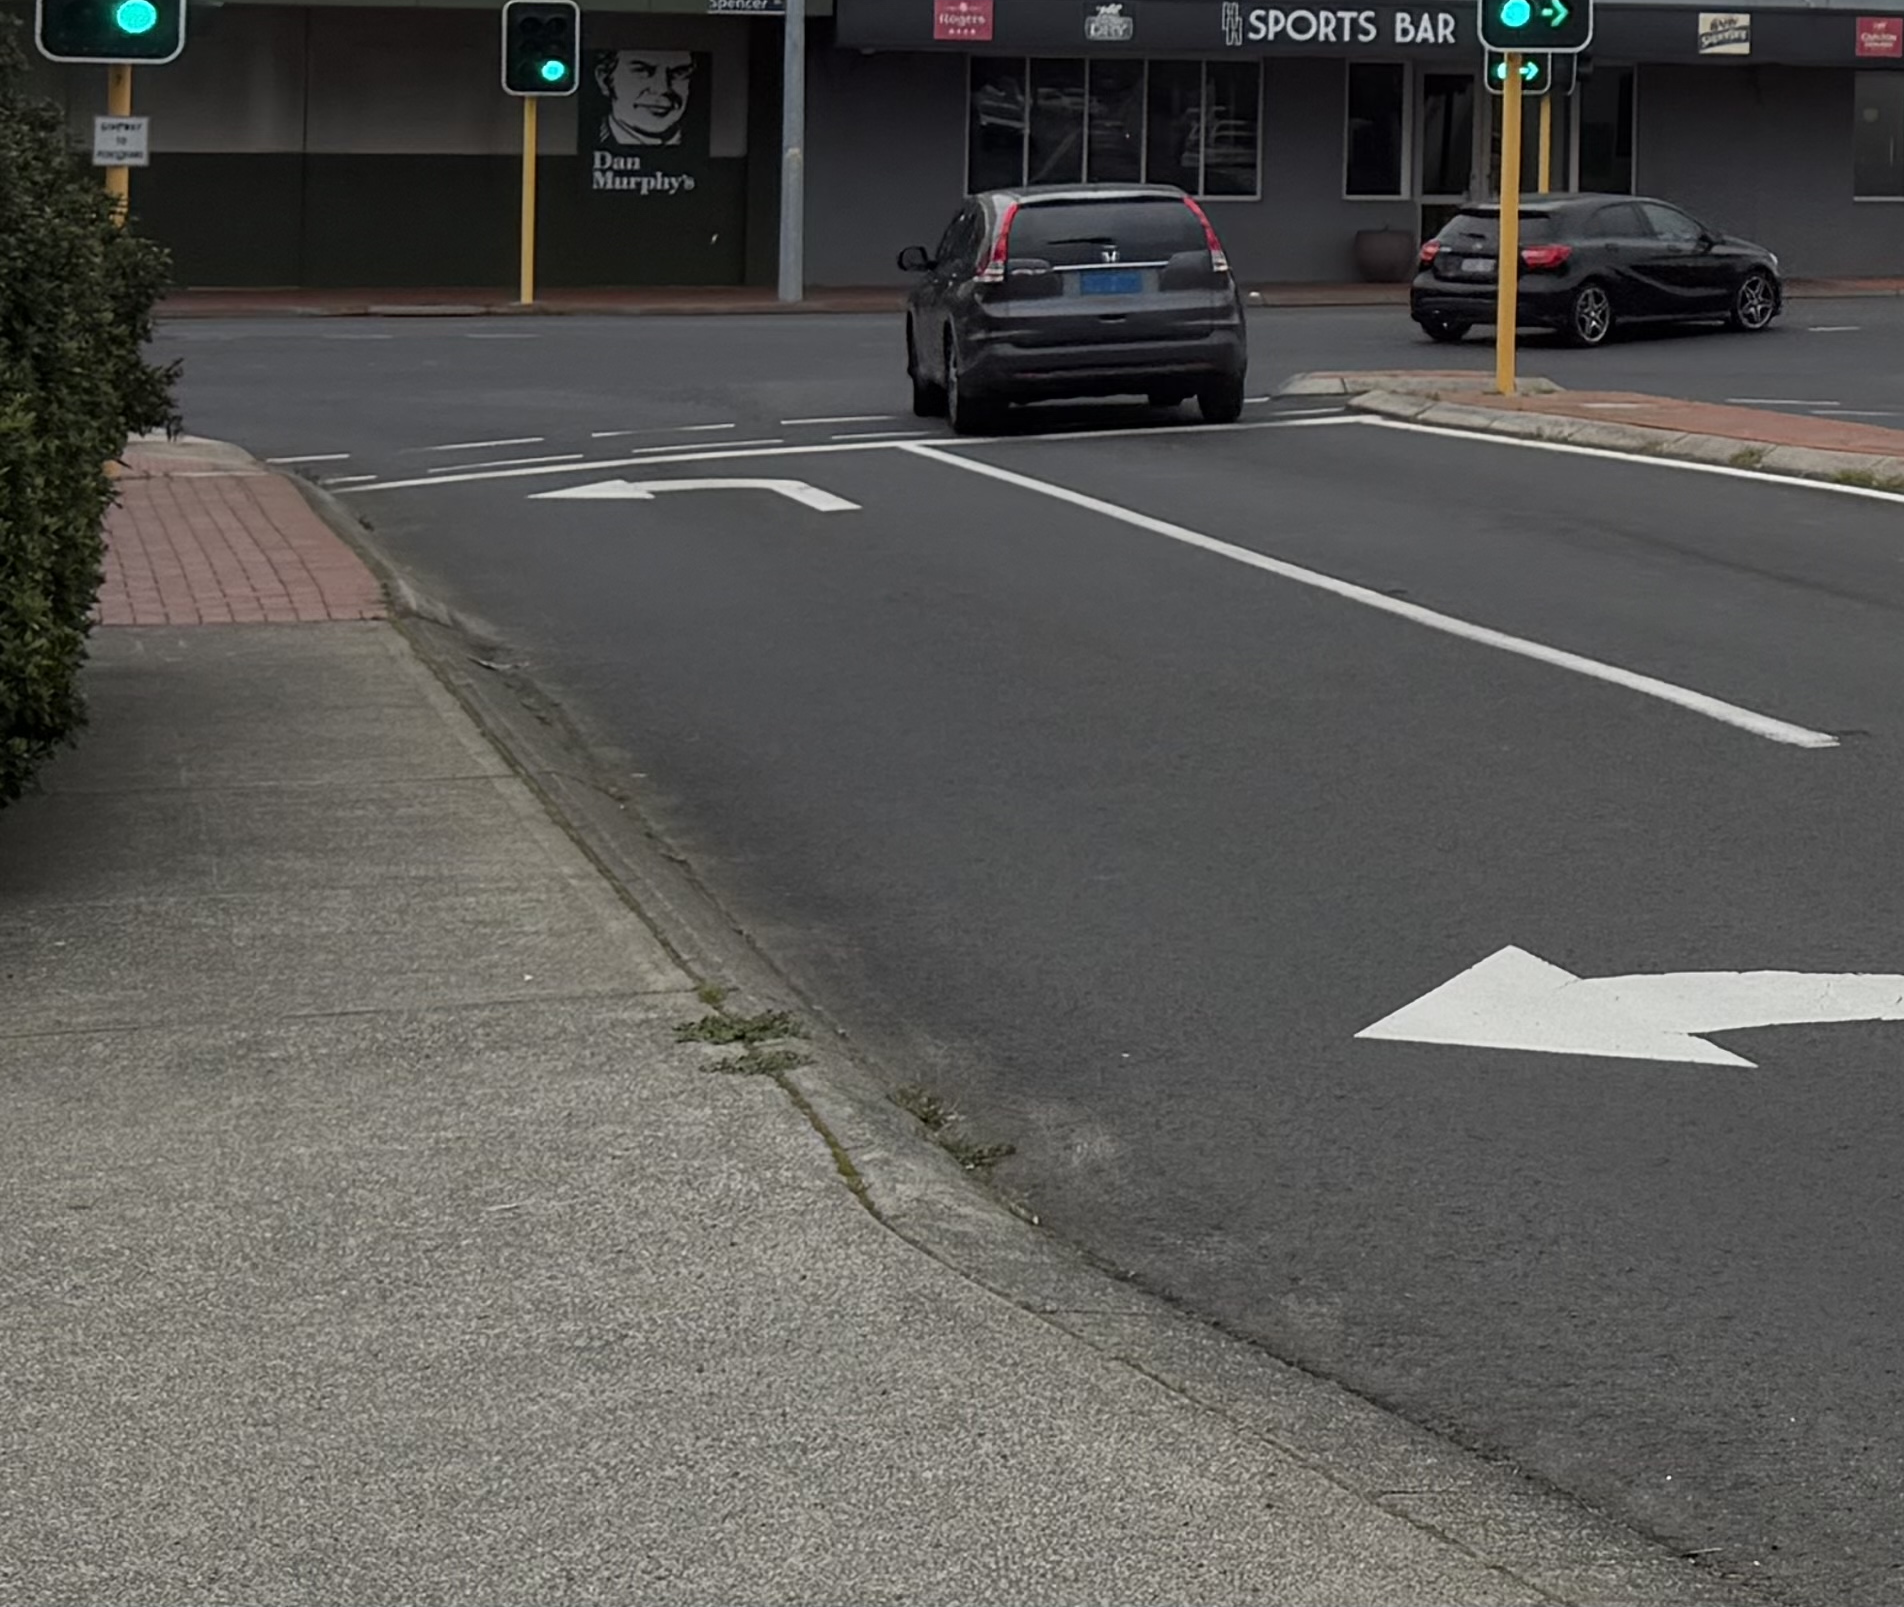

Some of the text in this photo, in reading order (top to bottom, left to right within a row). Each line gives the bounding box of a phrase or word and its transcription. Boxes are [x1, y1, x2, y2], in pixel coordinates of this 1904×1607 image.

[1248, 9, 1377, 42] SPORTS
[1394, 11, 1456, 44] BAR
[593, 151, 641, 171] Dan
[592, 170, 695, 195] Murphy's
